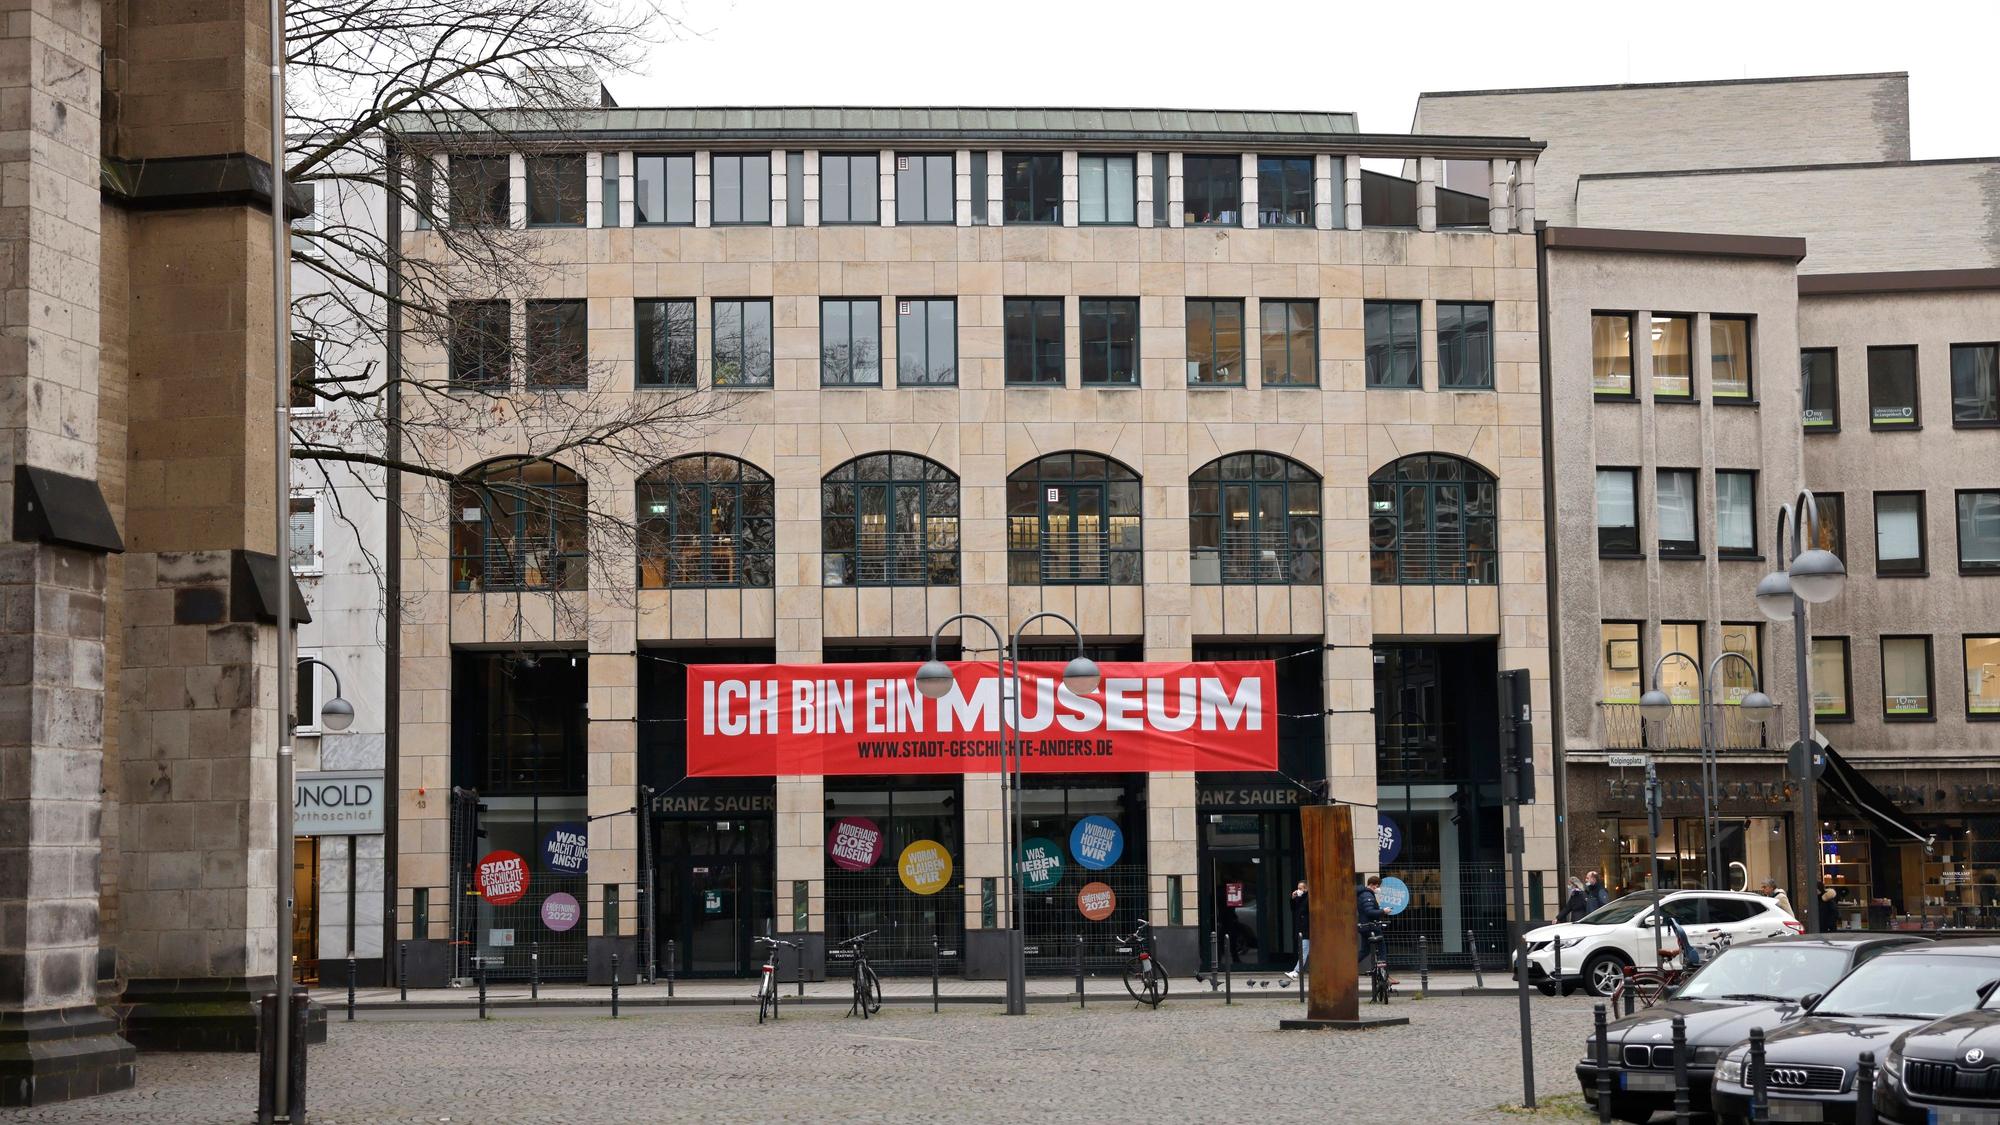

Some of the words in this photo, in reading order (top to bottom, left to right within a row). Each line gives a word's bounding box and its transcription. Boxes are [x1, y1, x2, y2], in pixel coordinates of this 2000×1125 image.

[703, 679, 778, 736] ICH
[792, 679, 854, 734] BIN
[866, 678, 924, 734] EIN
[937, 676, 1262, 733] MUSEUM
[858, 739, 1113, 758] WWW.STADT-GESCHICHTE-ANDERS.DE
[1610, 757, 1642, 766] Kolpingplatz
[652, 797, 709, 812] FRANZ
[714, 796, 774, 811] SAUER
[1240, 789, 1298, 804] SAUER
[556, 831, 586, 846] WAS
[838, 823, 878, 843] MODEHAUS
[1085, 822, 1116, 840] WORAUF
[1377, 824, 1392, 838] AS
[547, 841, 573, 855] MACHT
[836, 834, 874, 853] GOES
[1080, 834, 1112, 852] HOFFEN
[1378, 836, 1394, 850] EGT
[552, 853, 582, 869] ANGST
[832, 844, 872, 864] MUSEUM
[1026, 847, 1045, 860] WAS
[1082, 845, 1107, 861] WIR
[480, 858, 521, 875] STADT
[480, 869, 523, 887] GESCHICHTE
[914, 871, 940, 885] WIR
[1030, 869, 1049, 882] WIR
[486, 881, 521, 897] ANDERS
[1085, 900, 1110, 912] 2022
[547, 911, 573, 921] 2022
